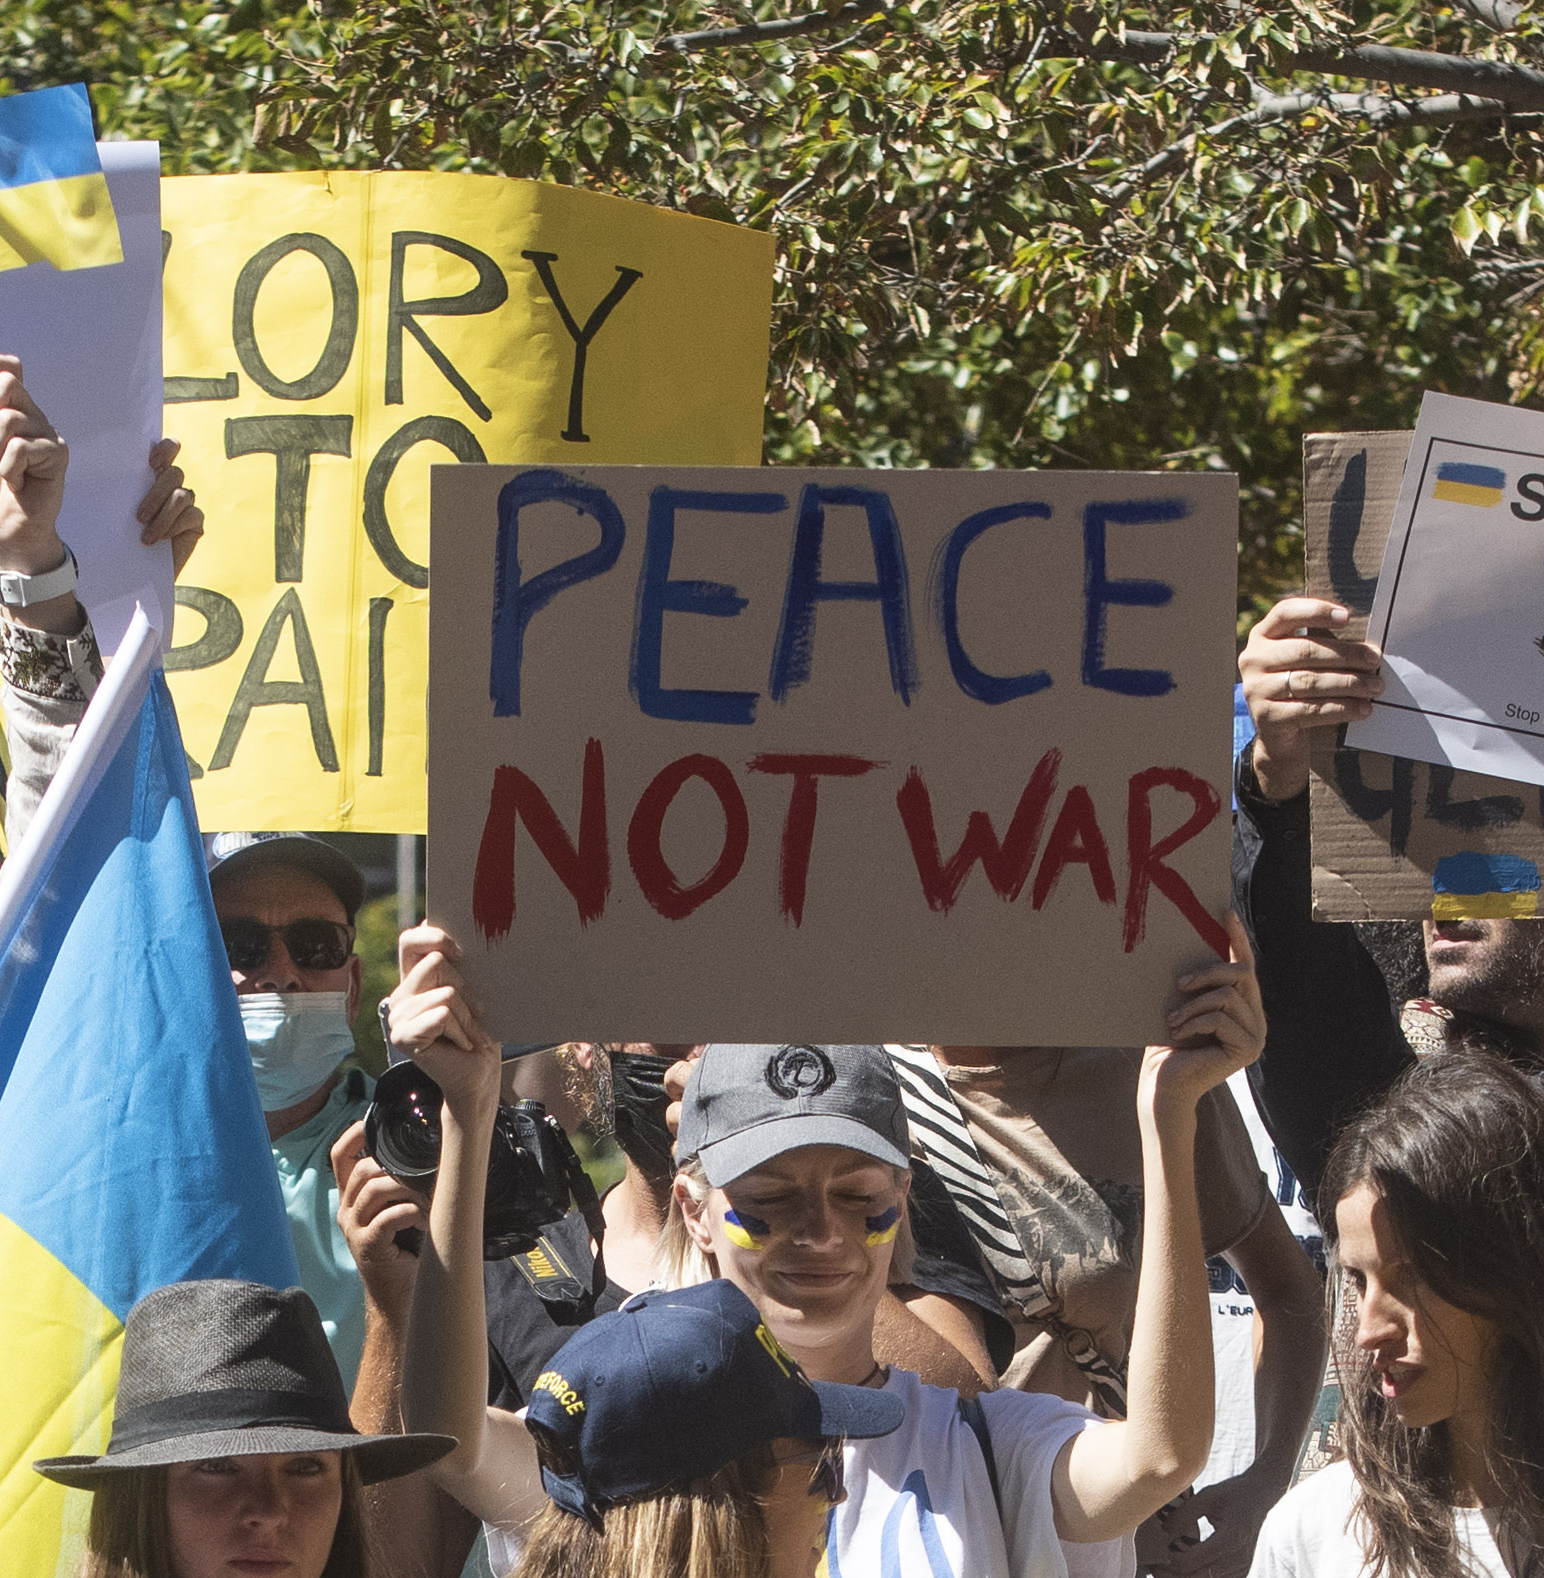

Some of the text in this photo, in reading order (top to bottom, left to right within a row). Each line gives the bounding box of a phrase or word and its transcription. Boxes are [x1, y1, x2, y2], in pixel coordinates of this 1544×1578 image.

[224, 414, 488, 590] TO
[490, 469, 1197, 724] PEACE
[1505, 703, 1540, 724] Stop
[474, 738, 890, 945] NOT
[897, 748, 1230, 961] WAR
